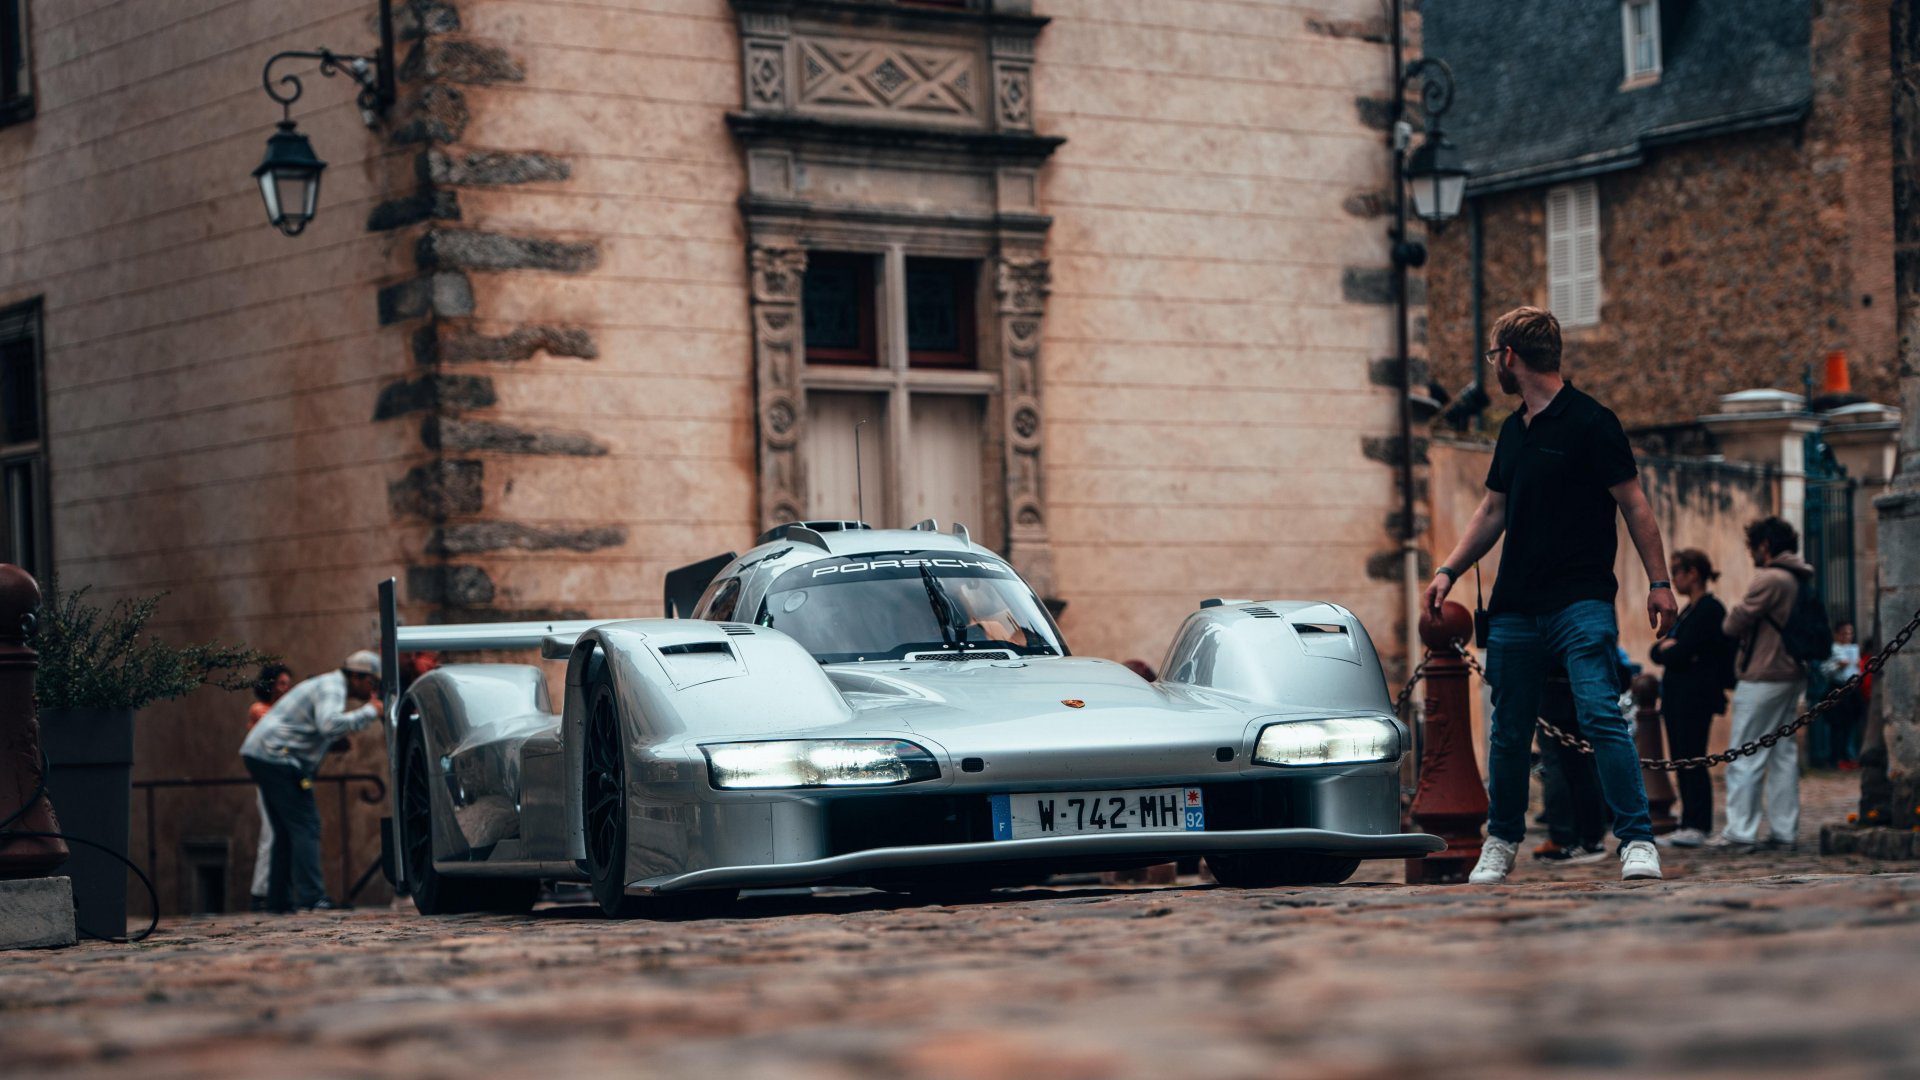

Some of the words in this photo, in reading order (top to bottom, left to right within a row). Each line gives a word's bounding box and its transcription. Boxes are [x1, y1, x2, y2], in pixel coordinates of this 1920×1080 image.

[812, 558, 1006, 578] PORSCHE
[1037, 794, 1178, 832] W-742-MH
[1186, 811, 1204, 828] 92
[999, 822, 1005, 832] F
